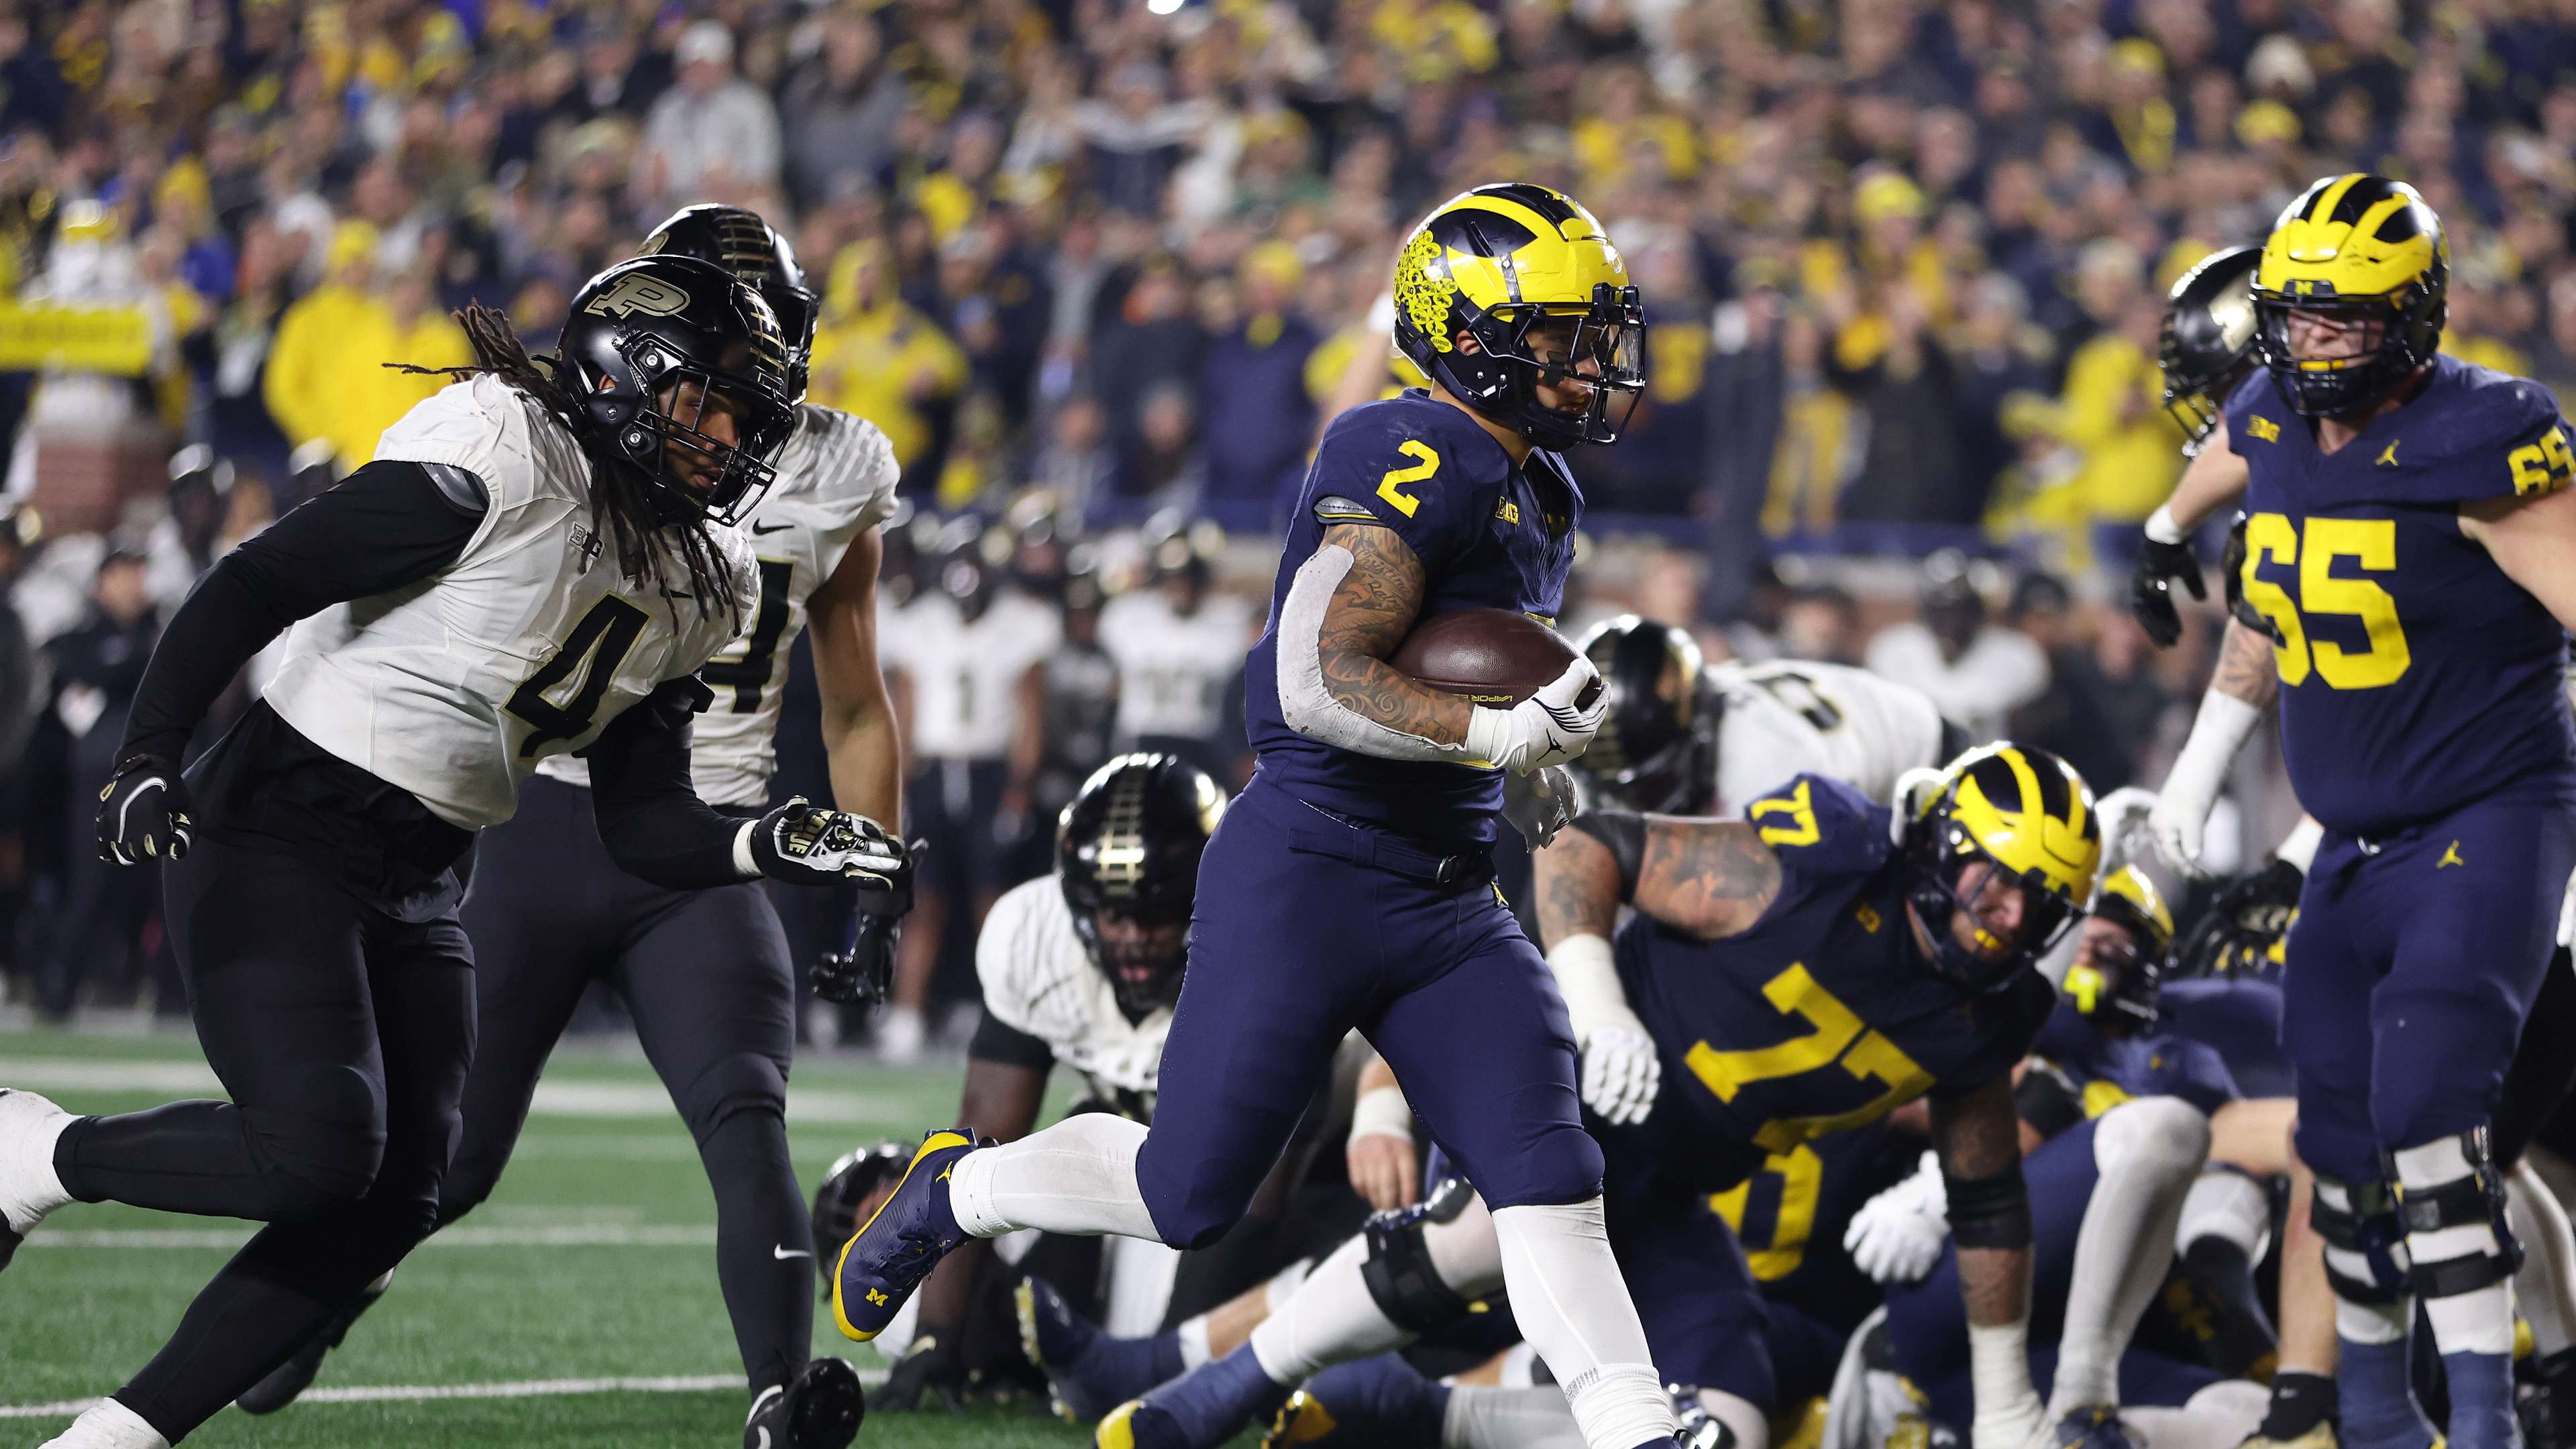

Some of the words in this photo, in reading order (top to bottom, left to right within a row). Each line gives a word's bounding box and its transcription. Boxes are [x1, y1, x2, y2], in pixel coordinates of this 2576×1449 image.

[1376, 439, 1440, 519] 2
[2508, 426, 2576, 496] 65
[2241, 512, 2411, 690] 65
[500, 590, 652, 761] 4
[1470, 694, 1513, 702] VAPOR
[1750, 780, 1821, 846] 77
[1684, 961, 1936, 1157] 77
[866, 1288, 888, 1307] M
